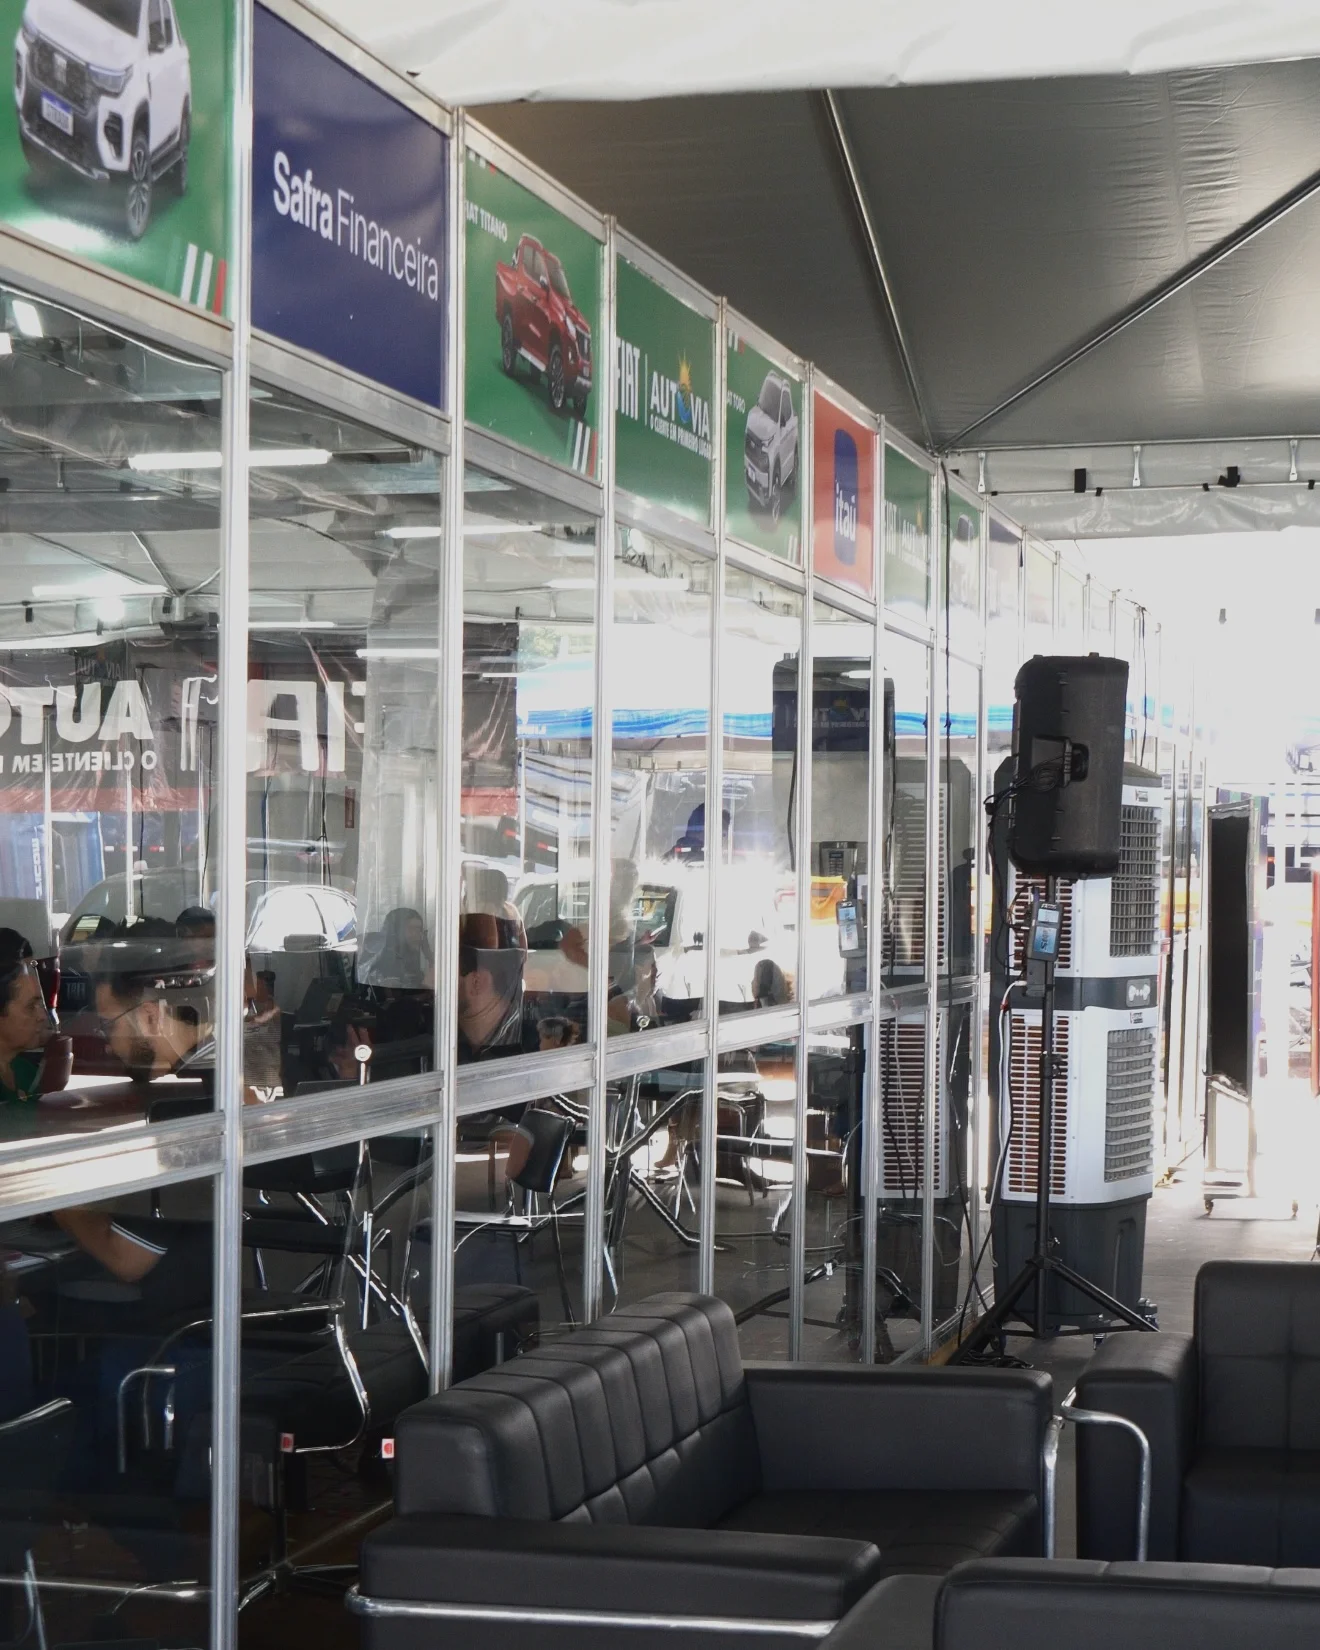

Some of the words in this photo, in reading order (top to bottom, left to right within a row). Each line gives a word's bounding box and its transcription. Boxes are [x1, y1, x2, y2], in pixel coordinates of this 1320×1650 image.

[273, 150, 334, 242] Safra
[336, 187, 439, 301] Financeira
[480, 207, 508, 243] TITANO
